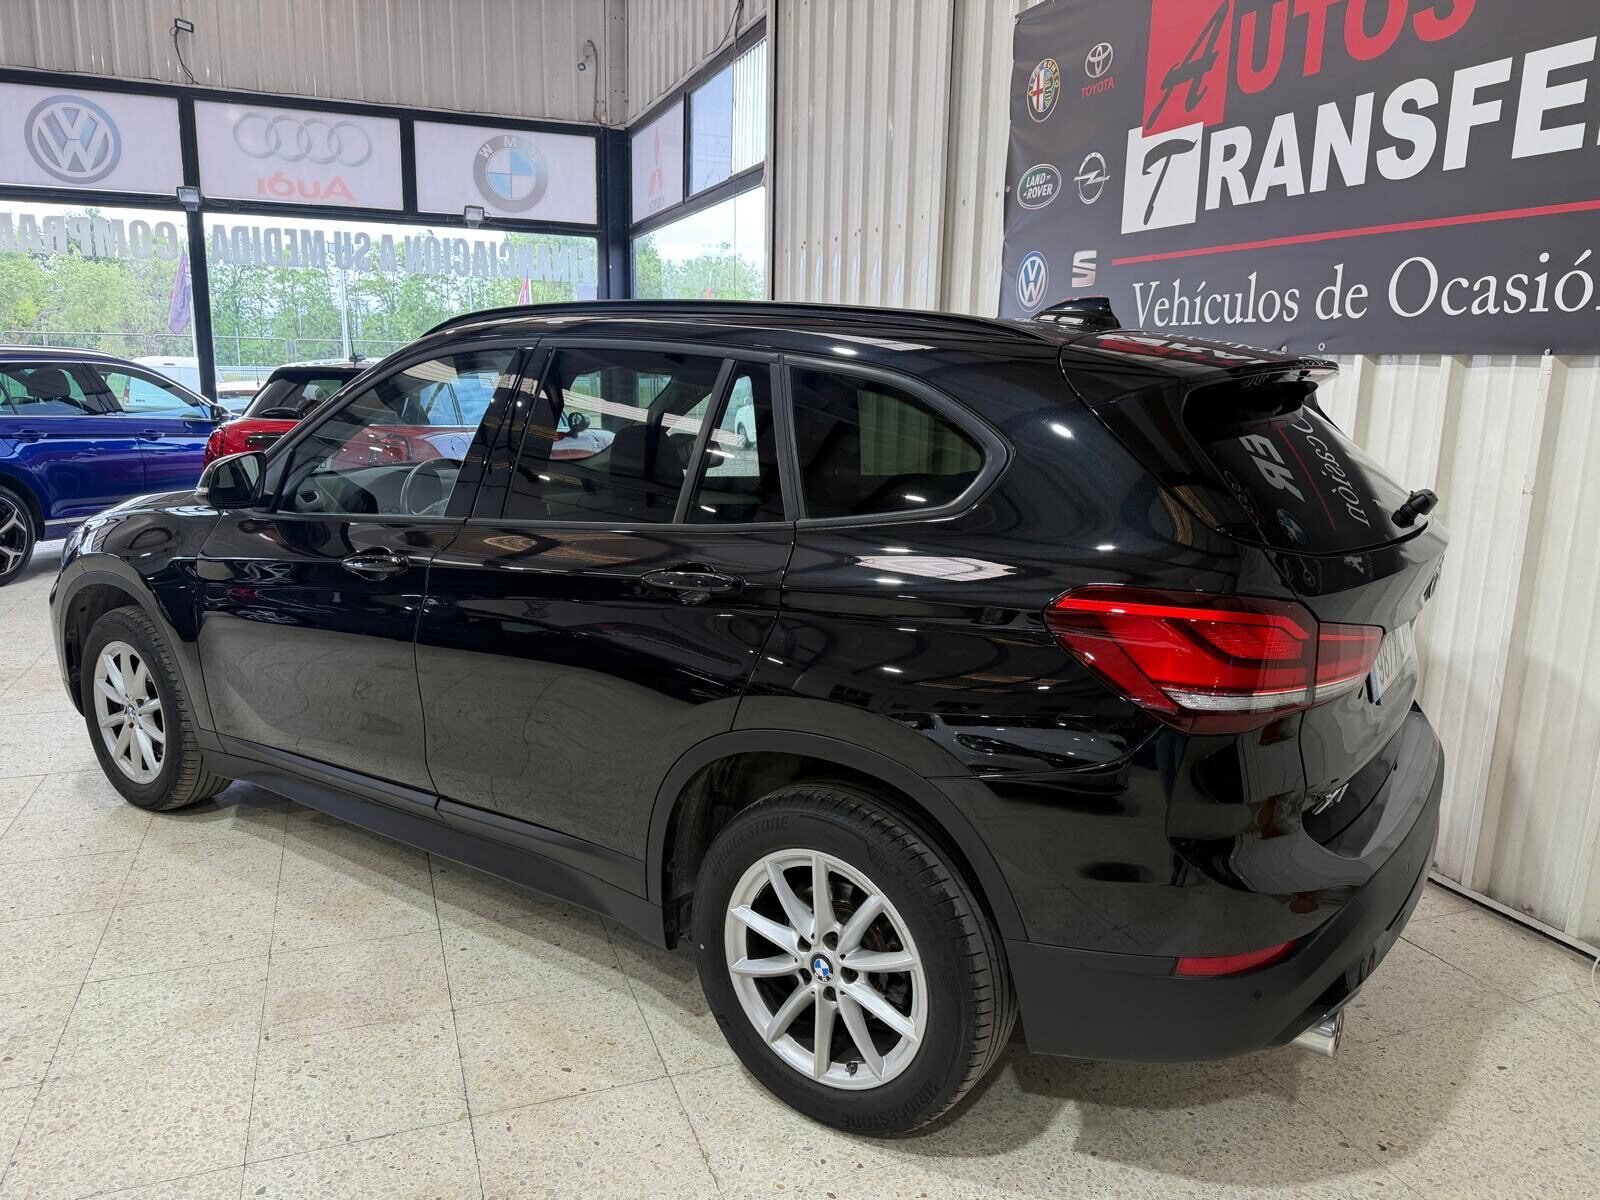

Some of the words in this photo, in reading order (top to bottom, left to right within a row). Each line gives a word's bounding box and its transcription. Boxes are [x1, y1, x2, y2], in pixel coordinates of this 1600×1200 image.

[1081, 78, 1115, 98] TOYOTA
[1140, 36, 1600, 226] TRANSFE
[1026, 173, 1046, 188] LAND
[1026, 183, 1054, 199] ROVER
[1133, 271, 1300, 329] Vehículos
[1315, 264, 1368, 320] de
[1389, 249, 1600, 318] Ocasió
